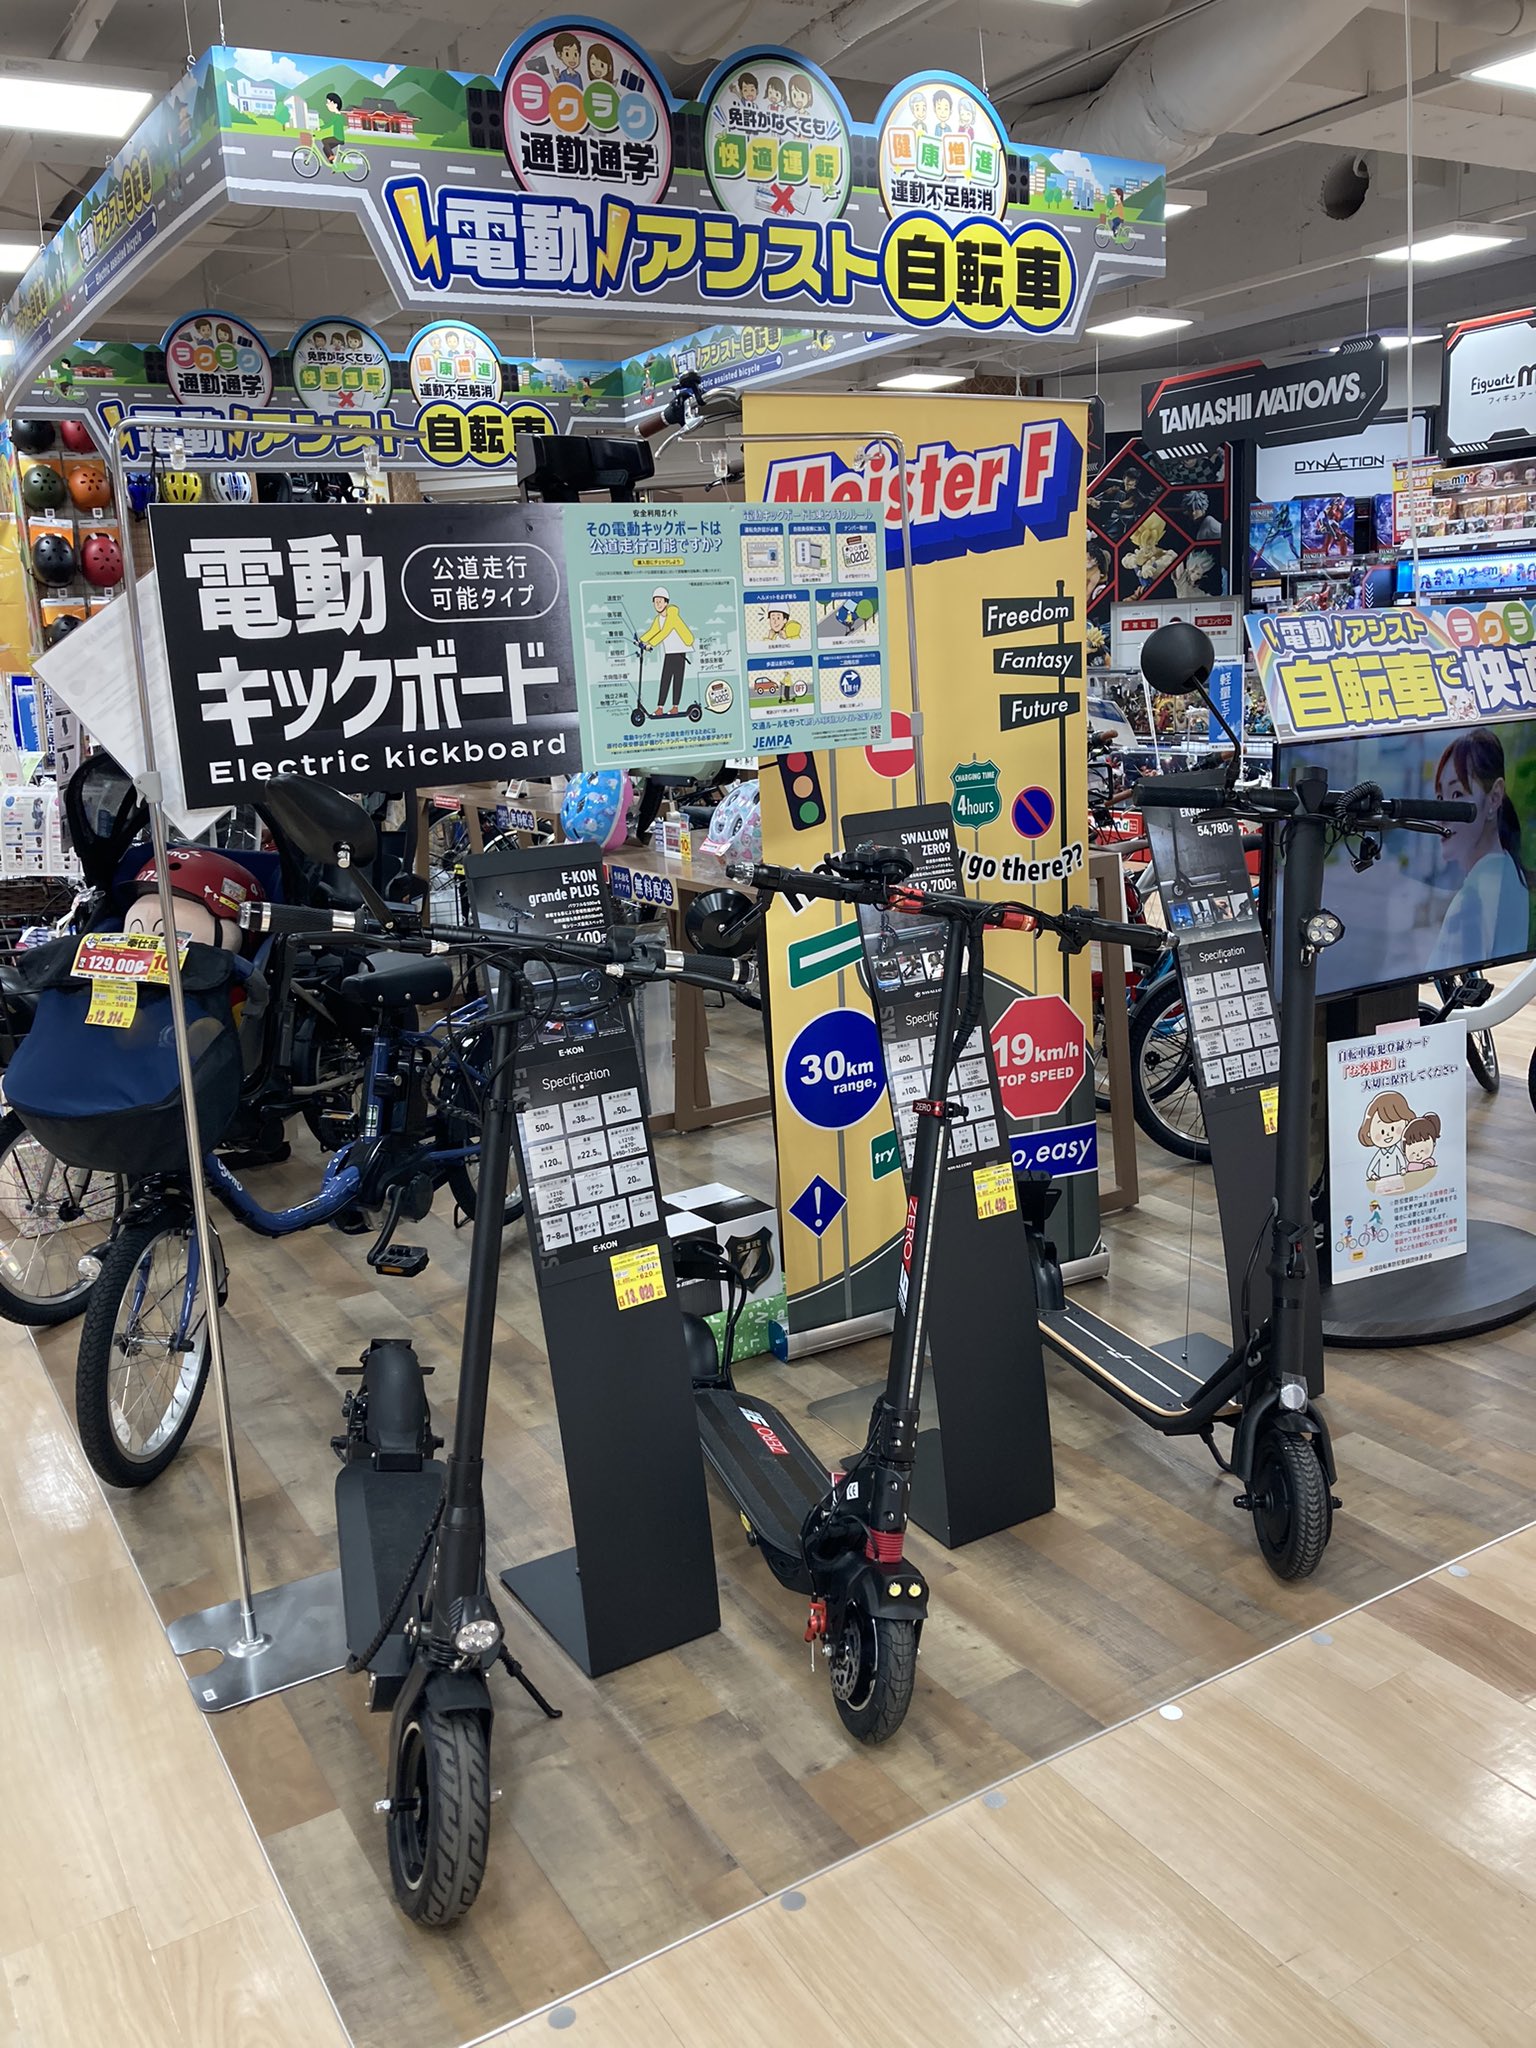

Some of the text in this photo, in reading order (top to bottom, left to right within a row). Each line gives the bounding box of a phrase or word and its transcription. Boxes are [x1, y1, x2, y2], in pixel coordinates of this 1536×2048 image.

[520, 84, 647, 128] ラクラク
[728, 106, 828, 138] 免許がなくても
[520, 131, 658, 182] 通勤通学
[717, 141, 836, 179] 快適運転
[891, 133, 994, 175] 健康増進
[891, 179, 993, 211] 運動不足解消
[175, 344, 256, 369] ラクラク
[307, 349, 373, 364] 免許がなくても
[418, 355, 492, 379] 健康増進
[178, 372, 264, 397] 通勤通学
[301, 369, 382, 390] 快適運転
[714, 370, 738, 386] assisted
[738, 363, 760, 381] bicycle
[1471, 374, 1516, 394] Figuarts
[420, 383, 493, 399] 運動不足解消
[1159, 372, 1360, 434] TAMASHII NATIONS
[773, 428, 1053, 521] Meister F
[1294, 452, 1386, 474] DYNACTION
[632, 509, 679, 518] 安全利用ガイド
[586, 520, 722, 537] その電動キックボードは
[431, 555, 527, 582] 公道走行
[850, 549, 870, 564] 0202
[183, 533, 388, 640] 電動
[430, 584, 535, 612] 可能タイプ
[986, 601, 1069, 631] Freedom
[1000, 651, 1074, 675] Fantasy
[197, 639, 560, 747] キックボード
[1011, 699, 1069, 723] Future
[752, 734, 793, 749] JEMPA
[208, 733, 567, 785] Electric kickboard
[954, 770, 995, 782] CHARGING TIME
[900, 827, 949, 845] SWALLOW
[921, 841, 951, 856] ZERO9
[968, 856, 996, 880] go
[1002, 843, 1083, 881] there??
[561, 868, 597, 886] E-KON
[529, 884, 600, 908] grande PLUS
[634, 877, 673, 902] 無料配送
[1199, 943, 1246, 963] Specification
[558, 1045, 585, 1057] E-KON
[992, 1033, 1079, 1068] 19km/h
[1338, 1036, 1430, 1063] 自転車防犯登録カード
[541, 1066, 611, 1091] Specification
[799, 1050, 874, 1086] 30km
[997, 1072, 1021, 1088] TOP
[1022, 1066, 1074, 1085] SPEED
[1360, 1064, 1459, 1091] 大切に保管してください
[832, 1077, 877, 1096] range,
[915, 1102, 932, 1112] ZERO
[874, 1145, 896, 1165] try
[903, 1198, 919, 1260] ZERO
[592, 1239, 618, 1253] E-KON
